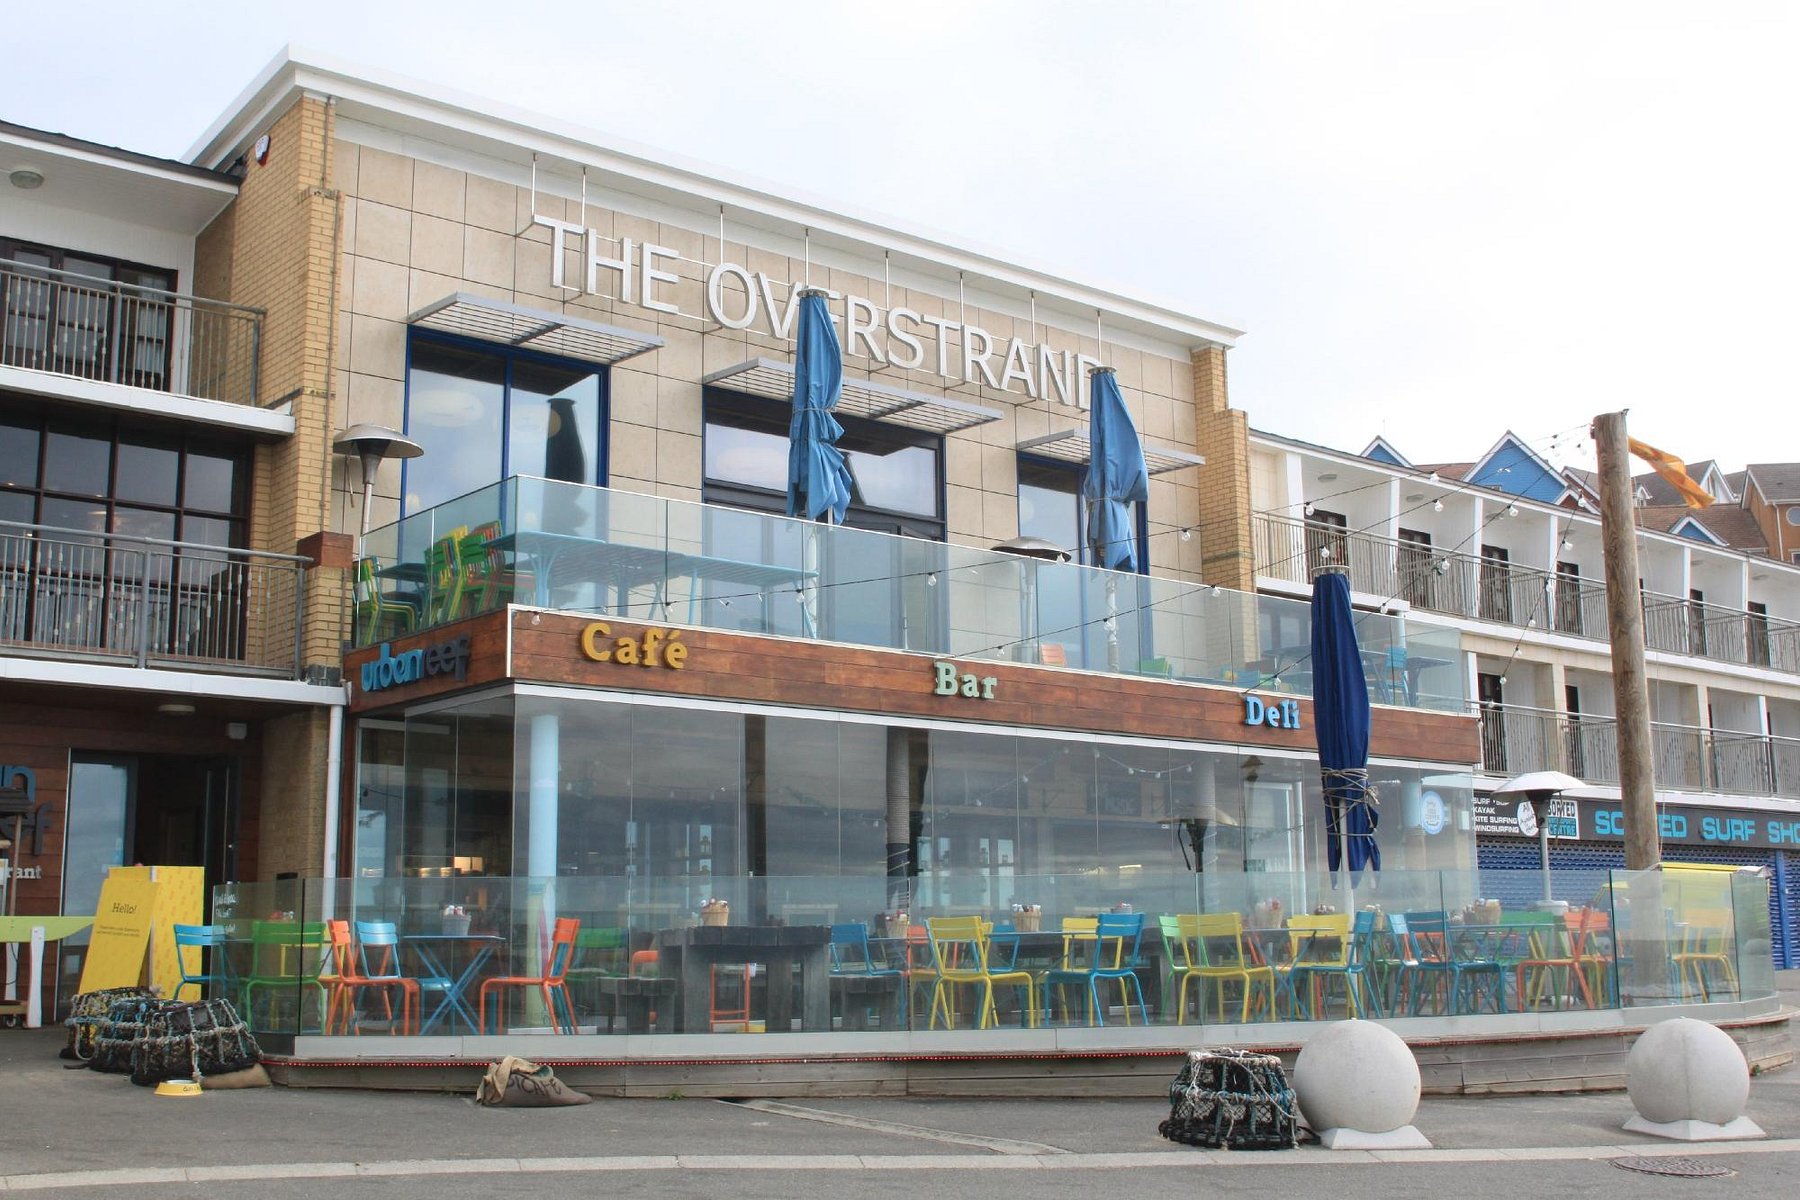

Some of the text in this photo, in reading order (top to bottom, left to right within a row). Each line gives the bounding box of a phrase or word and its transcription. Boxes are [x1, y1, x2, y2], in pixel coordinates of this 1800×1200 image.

[532, 213, 680, 315] THE
[581, 622, 688, 669] Café
[935, 660, 997, 699] Bar
[1246, 696, 1300, 729] Deli
[1475, 825, 1519, 834] WINDSURFING
[1702, 816, 1756, 842] SURF
[112, 902, 137, 914] Hello!
